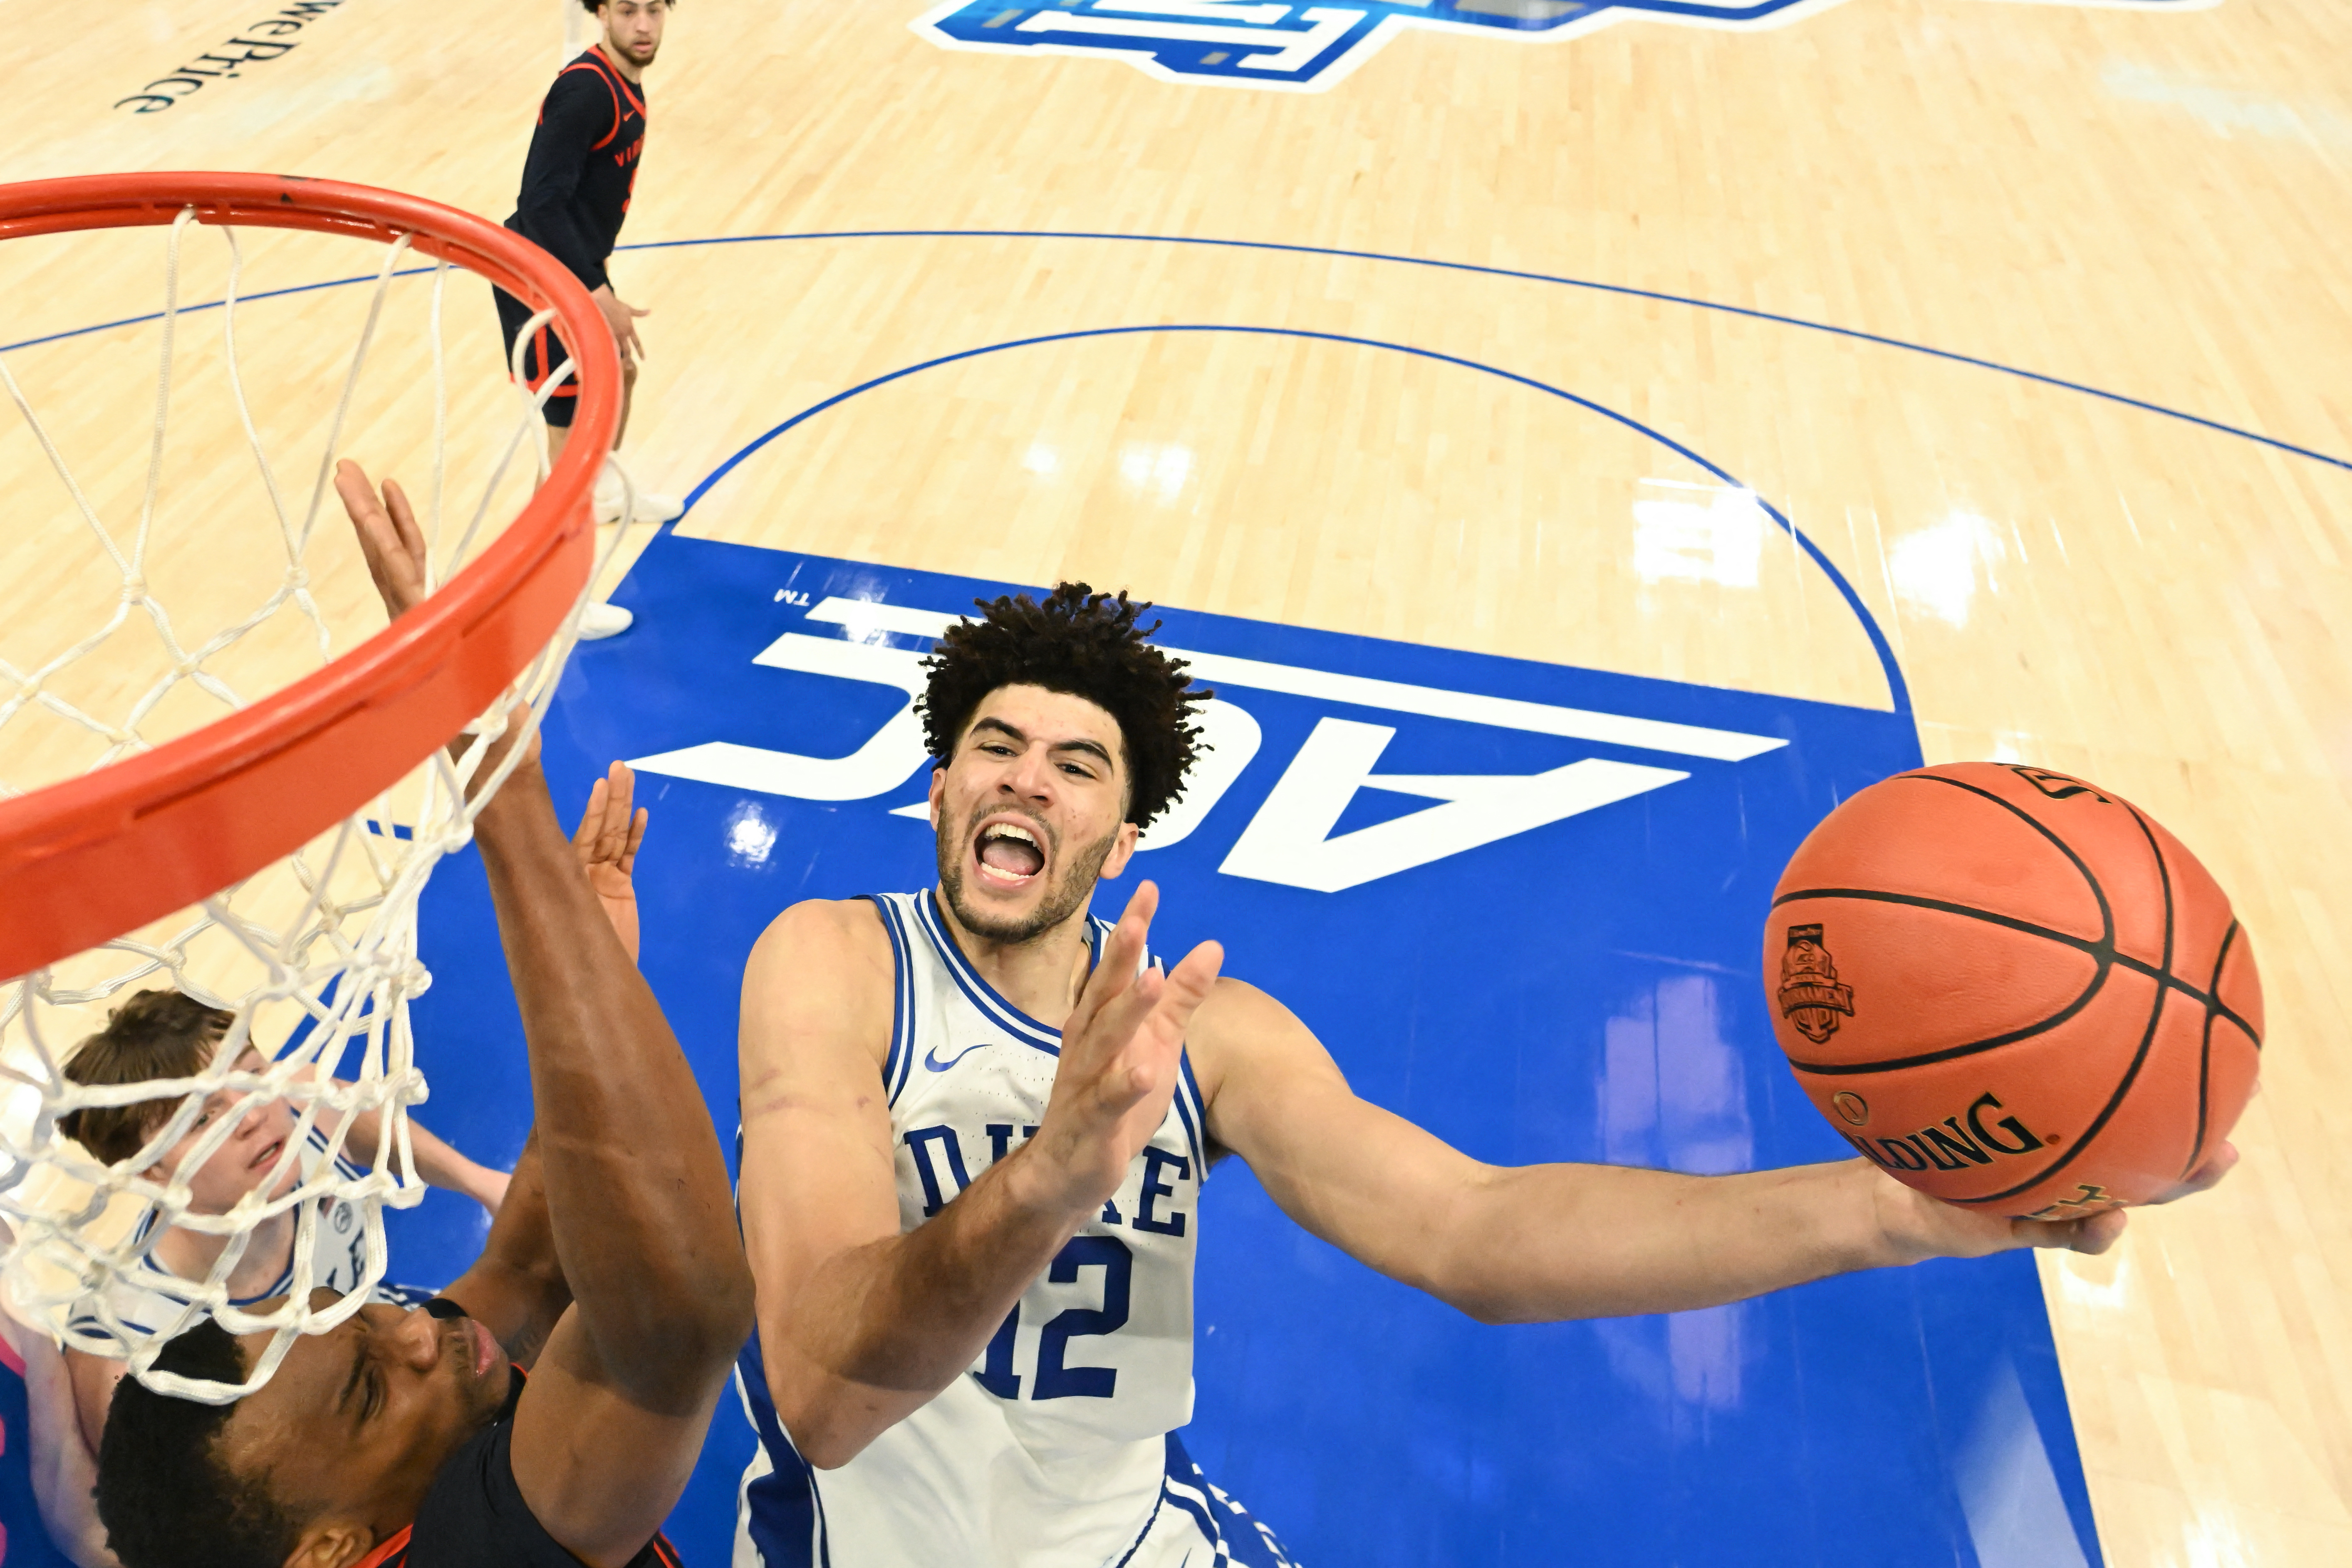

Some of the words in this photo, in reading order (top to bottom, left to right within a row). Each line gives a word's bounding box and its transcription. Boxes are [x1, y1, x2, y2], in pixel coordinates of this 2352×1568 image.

[774, 589, 810, 606] TM
[1839, 1091, 2045, 1171] LDING
[904, 1124, 1191, 1237] DE
[973, 1236, 1133, 1400] 12
